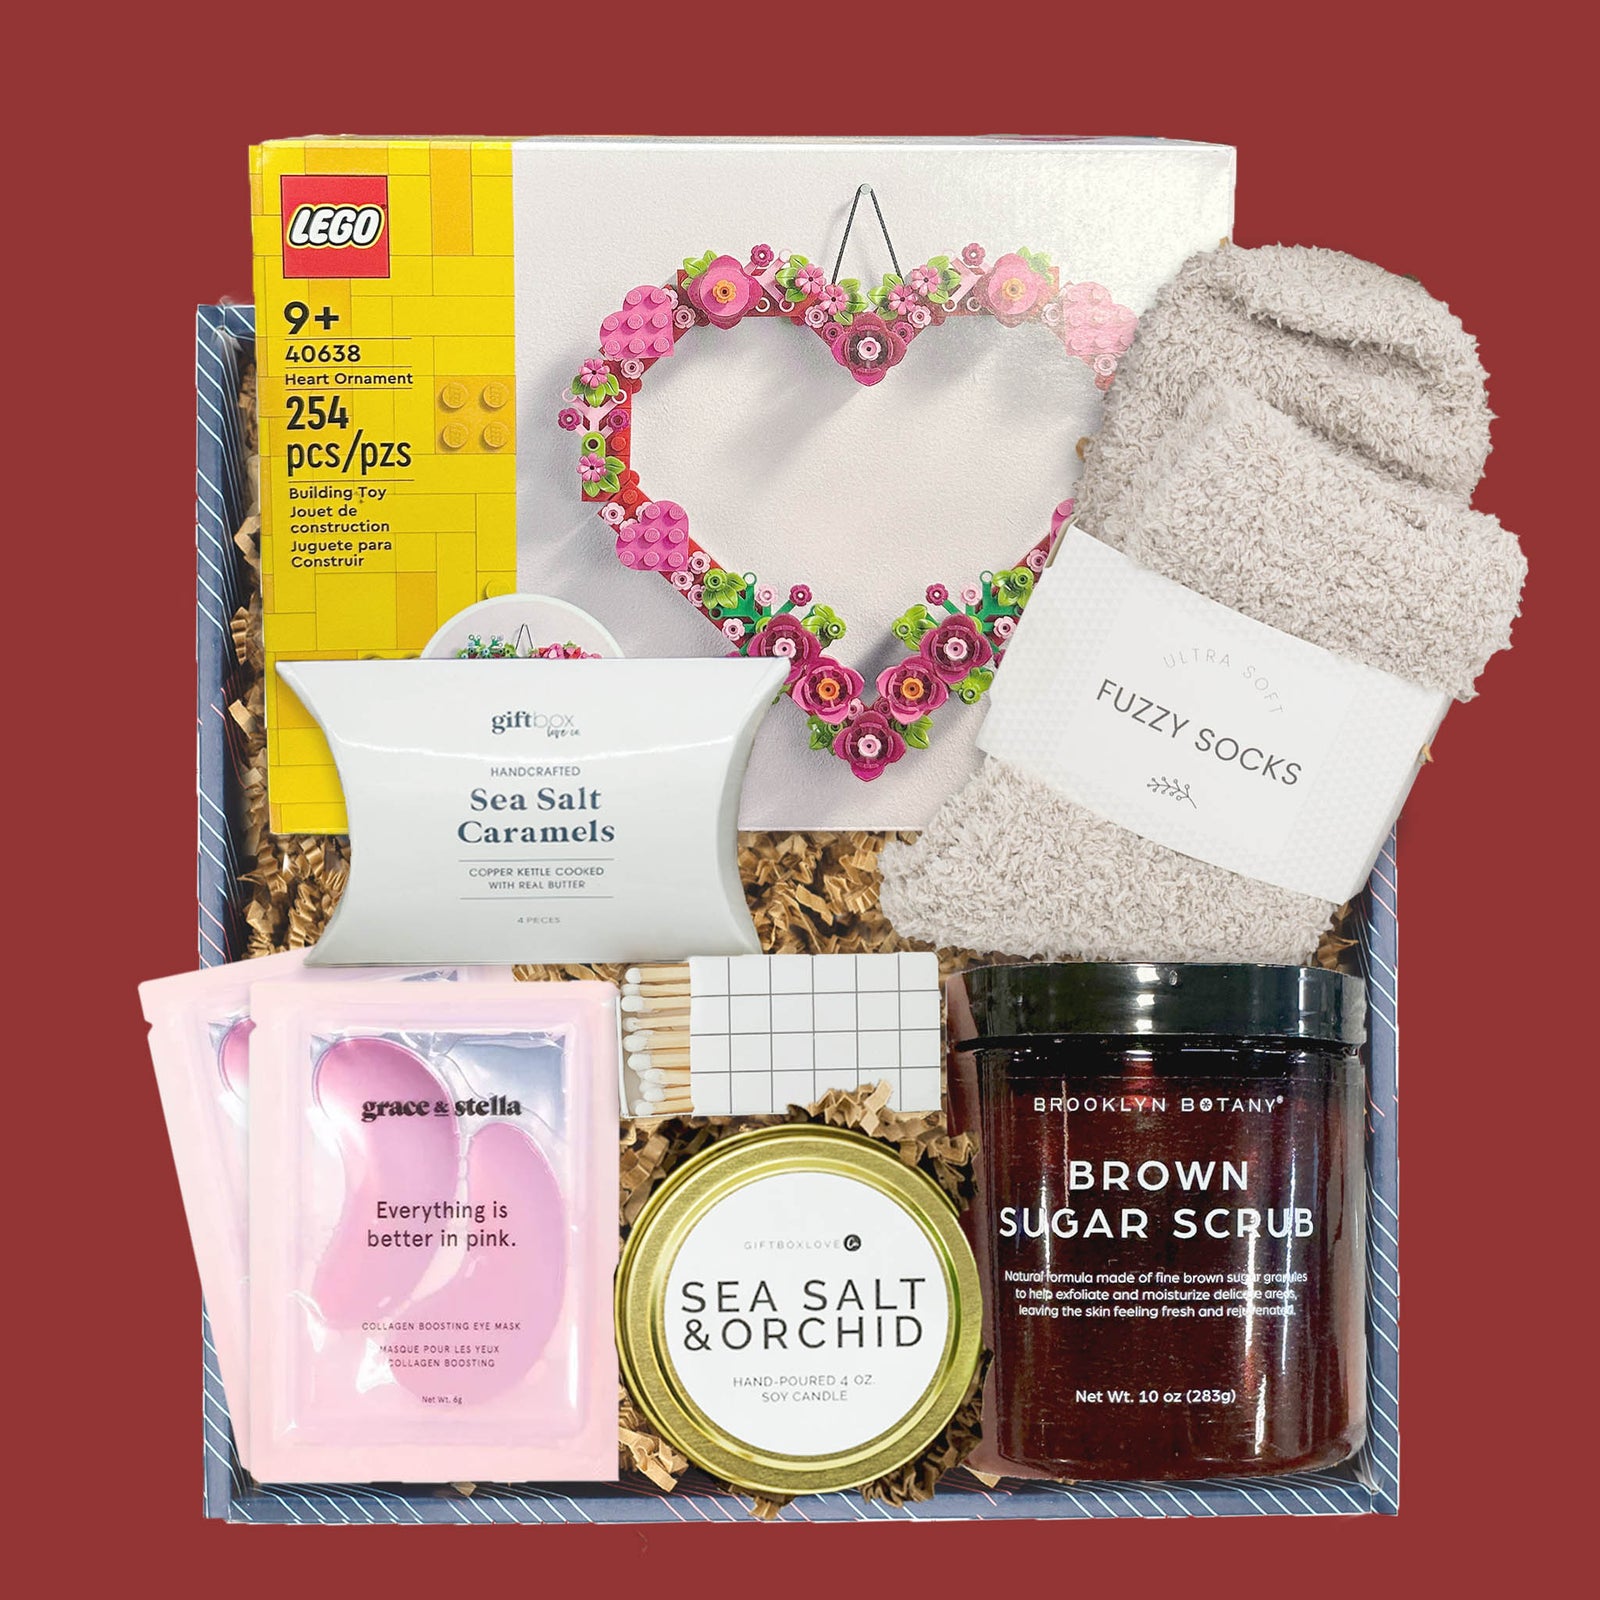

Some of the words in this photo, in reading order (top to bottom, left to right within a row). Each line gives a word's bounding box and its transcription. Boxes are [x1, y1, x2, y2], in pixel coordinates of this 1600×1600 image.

[288, 206, 382, 247] LEGO
[283, 301, 340, 335] 9+
[285, 345, 361, 362] 40638
[285, 373, 329, 386] Heart
[334, 372, 413, 385] Ornament
[286, 395, 349, 430] 254
[287, 429, 412, 477] pcs/pzs
[289, 486, 353, 501] Building
[358, 486, 387, 501] Toy
[290, 506, 333, 518] Jouet
[338, 504, 357, 516] de
[290, 520, 390, 533] construction
[291, 540, 353, 554] Juguete
[358, 541, 392, 553] para
[291, 554, 365, 568] Construir
[1163, 648, 1230, 669] ULTRA
[1242, 665, 1284, 713] SOFT
[491, 711, 574, 735] giftbox
[1096, 678, 1190, 738] FUZZY
[1194, 728, 1302, 786] SOCKS
[490, 766, 581, 777] HANDCRAFTED
[470, 787, 527, 811] Sea
[537, 786, 602, 811] Salt
[457, 820, 615, 843] Caramels
[469, 867, 513, 877] COPPER
[517, 867, 551, 877] KETTLE
[555, 867, 604, 876] COOKED
[489, 881, 515, 889] WITH
[519, 880, 544, 889] REAL
[548, 880, 586, 889] BUTTER
[361, 1100, 430, 1123] grace
[434, 1101, 449, 1117] &
[454, 1095, 523, 1116] stella
[1034, 1097, 1166, 1112] BROOKLYN
[1069, 1160, 1248, 1191] BROWN
[377, 1201, 486, 1224] Everything
[492, 1201, 508, 1219] is
[1000, 1207, 1148, 1239] SUGAR
[1172, 1207, 1314, 1239] SCRUB
[368, 1229, 433, 1247] better
[441, 1229, 458, 1247] in
[467, 1229, 516, 1251] pink.
[744, 1239, 840, 1250] GIFTBOXLOVE
[1004, 1270, 1044, 1282] Natural
[1046, 1271, 1093, 1284] formula
[1096, 1272, 1135, 1284] made
[1138, 1272, 1153, 1284] of
[1155, 1271, 1180, 1284] fine
[1183, 1272, 1224, 1284] brown
[681, 1280, 777, 1313] SEA
[802, 1277, 926, 1311] SALT
[1015, 1288, 1027, 1299] to
[1029, 1288, 1053, 1301] help
[1055, 1288, 1110, 1301] exfoliate
[1112, 1289, 1139, 1301] and
[1142, 1289, 1211, 1301] moisturize
[1213, 1289, 1262, 1301] delice
[1019, 1304, 1059, 1319] leaving
[1062, 1305, 1082, 1317] the
[1085, 1305, 1111, 1317] skin
[1113, 1305, 1159, 1319] feeling
[1161, 1305, 1195, 1318] fresh
[1198, 1305, 1224, 1317] and
[361, 1322, 415, 1331] COLLAGEN
[418, 1322, 469, 1331] BOOSTING
[473, 1322, 491, 1331] EYE
[494, 1322, 521, 1331] MASK
[683, 1315, 923, 1351] &ORCHID
[380, 1345, 419, 1354] MASQUE
[423, 1345, 450, 1354] POUR
[454, 1345, 472, 1354] LES
[475, 1345, 499, 1354] YEUX
[388, 1359, 440, 1368] COLLAGEN
[444, 1359, 495, 1368] BOOSTING
[733, 1375, 836, 1387] HAND-POURED
[839, 1375, 849, 1386] 4
[422, 1396, 436, 1404] Net
[761, 1391, 789, 1402] SOY
[792, 1390, 848, 1402] CANDLE
[1075, 1390, 1103, 1403] Net
[1106, 1390, 1135, 1403] Wt.
[1138, 1390, 1159, 1403] 10
[1163, 1392, 1182, 1403] oz
[1186, 1389, 1237, 1405] (283g)
